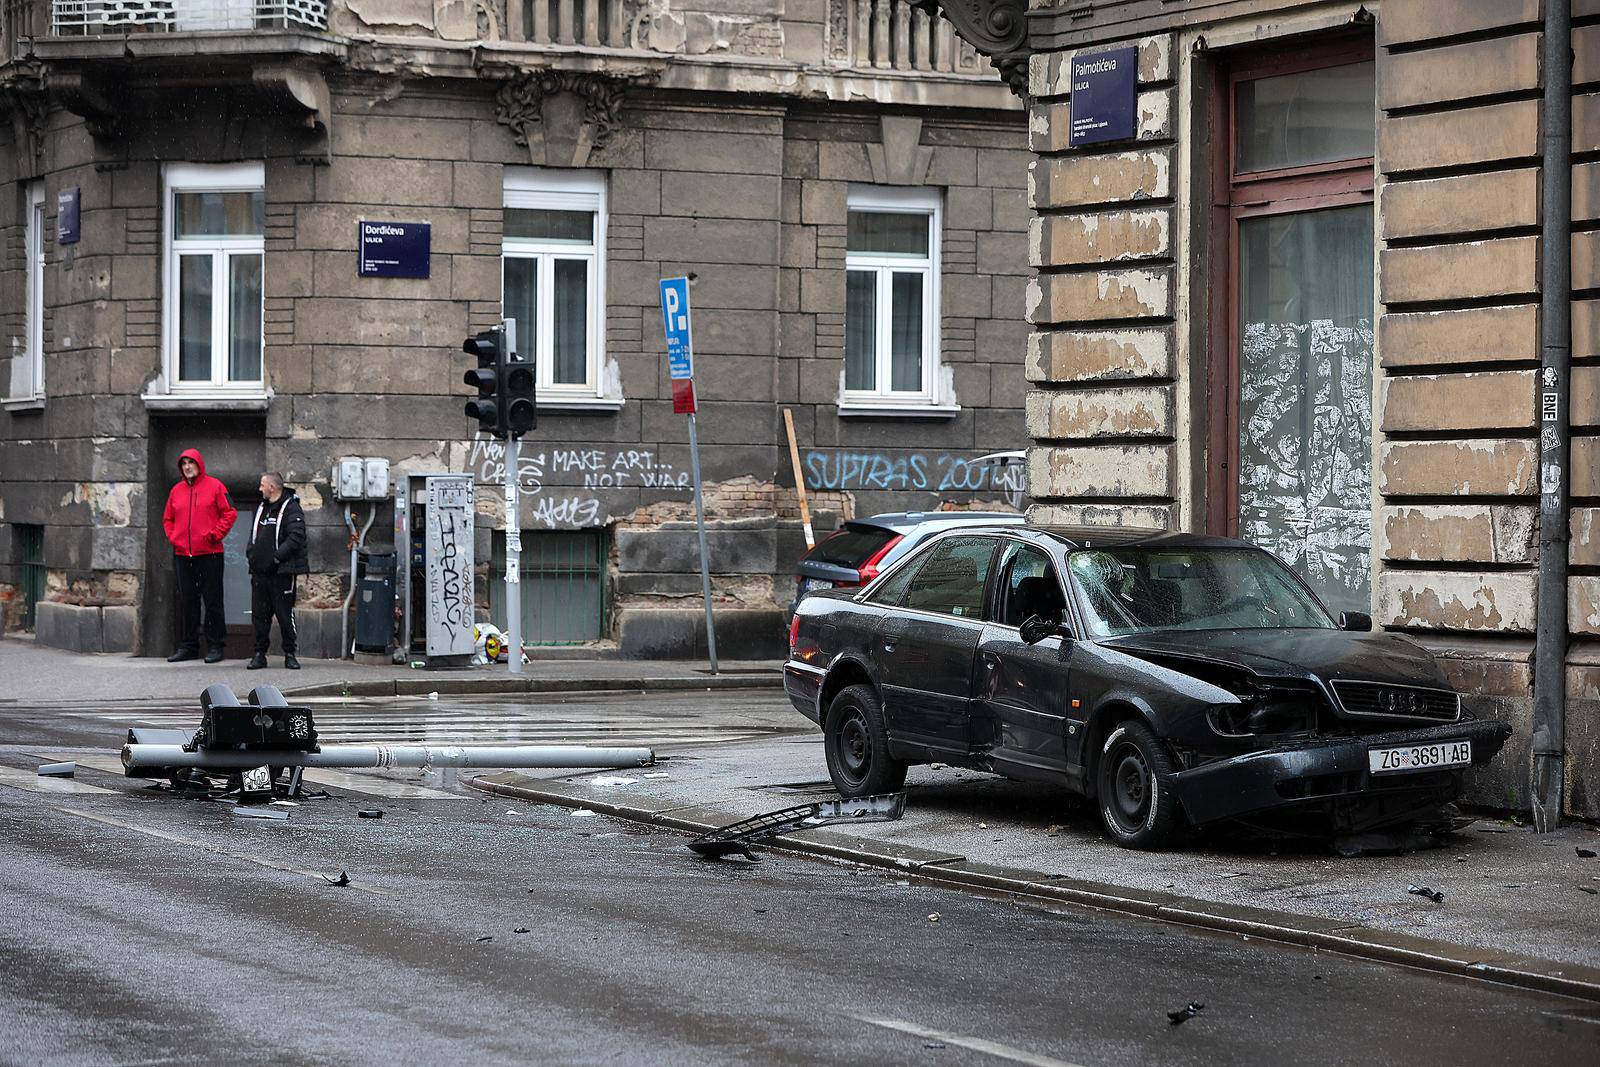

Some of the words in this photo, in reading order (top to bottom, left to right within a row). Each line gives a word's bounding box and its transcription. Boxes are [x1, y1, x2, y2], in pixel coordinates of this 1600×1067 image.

[1076, 58, 1116, 76] Palmotićeva
[1075, 81, 1089, 90] ULICA
[365, 225, 404, 235] Đorđićeva
[665, 287, 679, 332] P
[1544, 394, 1557, 421] BNE
[553, 449, 607, 472] MAKE
[584, 473, 630, 490] NOT
[1380, 751, 1400, 769] ZG
